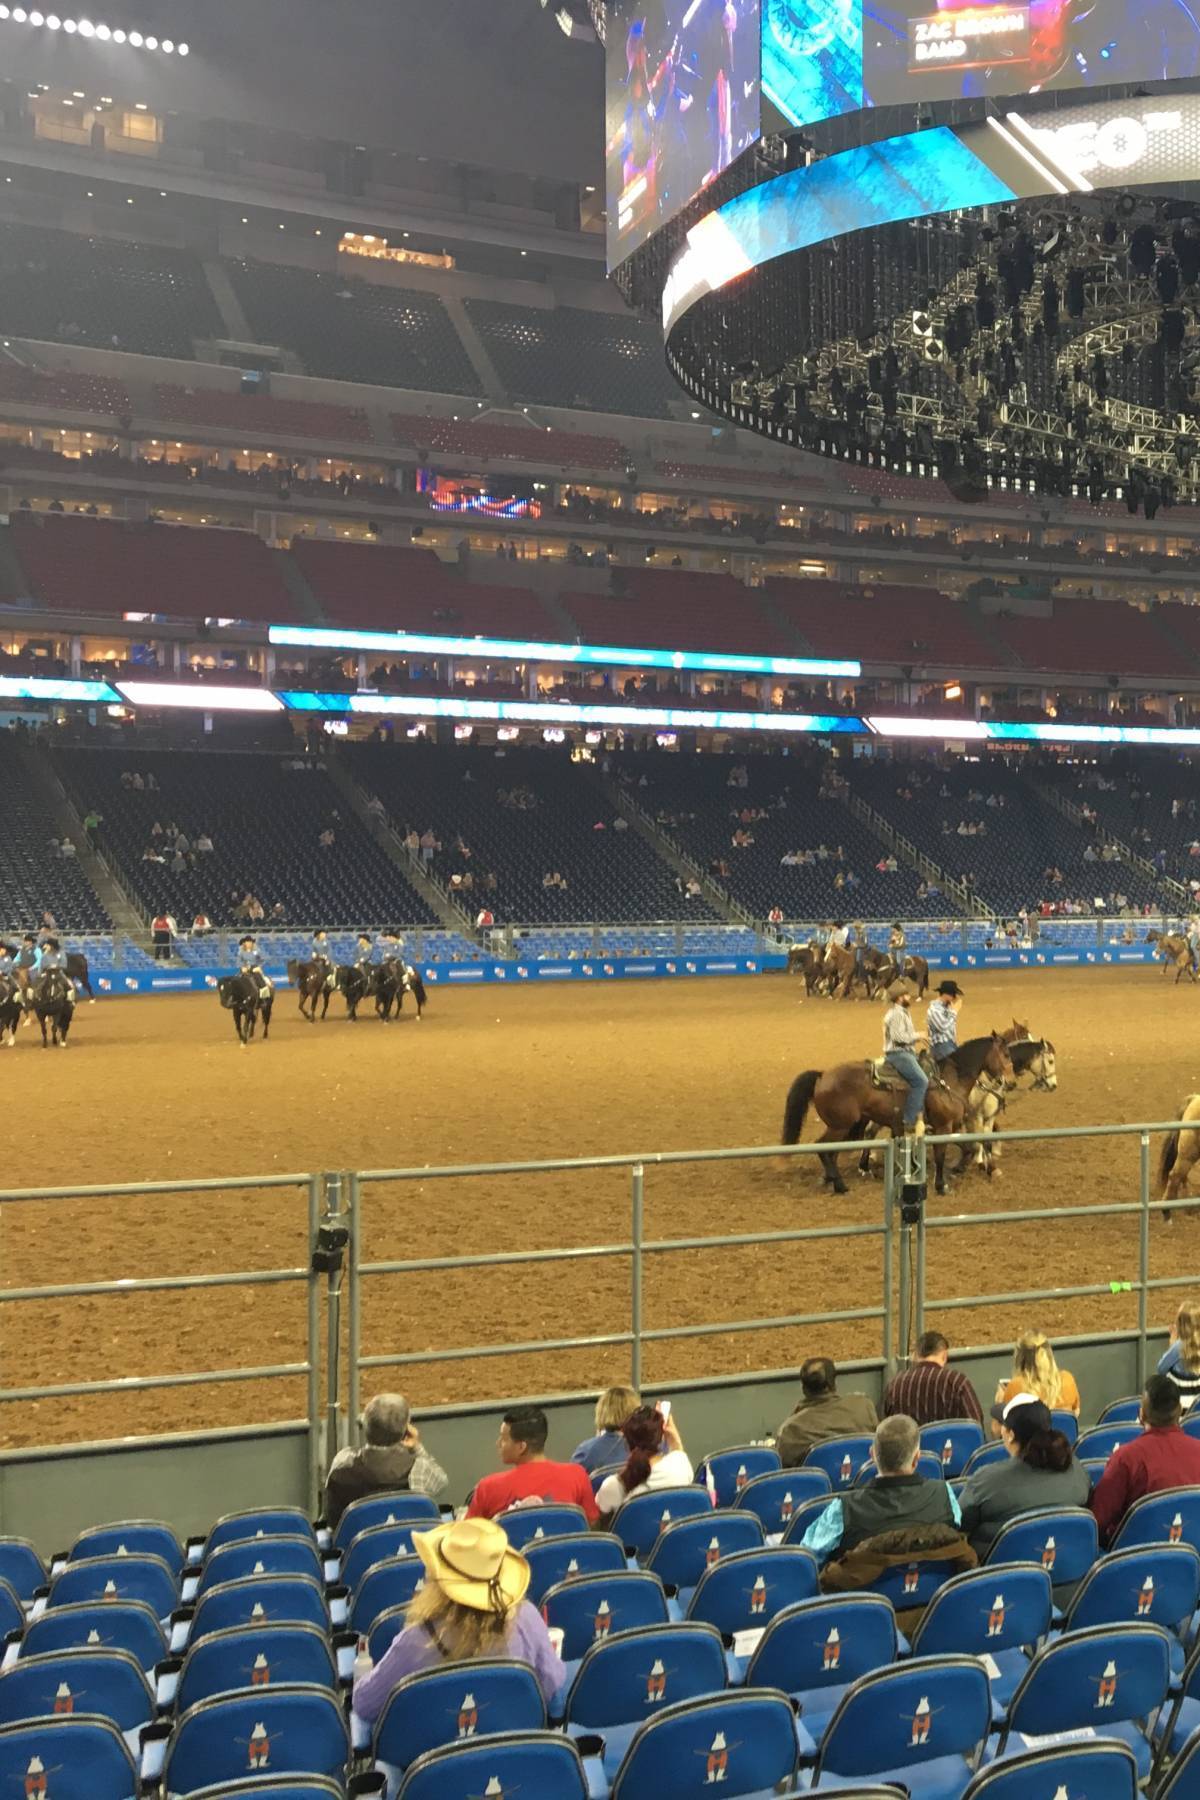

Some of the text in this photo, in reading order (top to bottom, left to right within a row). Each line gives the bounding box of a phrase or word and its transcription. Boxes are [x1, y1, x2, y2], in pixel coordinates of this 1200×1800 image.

[915, 14, 1025, 41] ZAC BROWN
[915, 40, 967, 60] BAND
